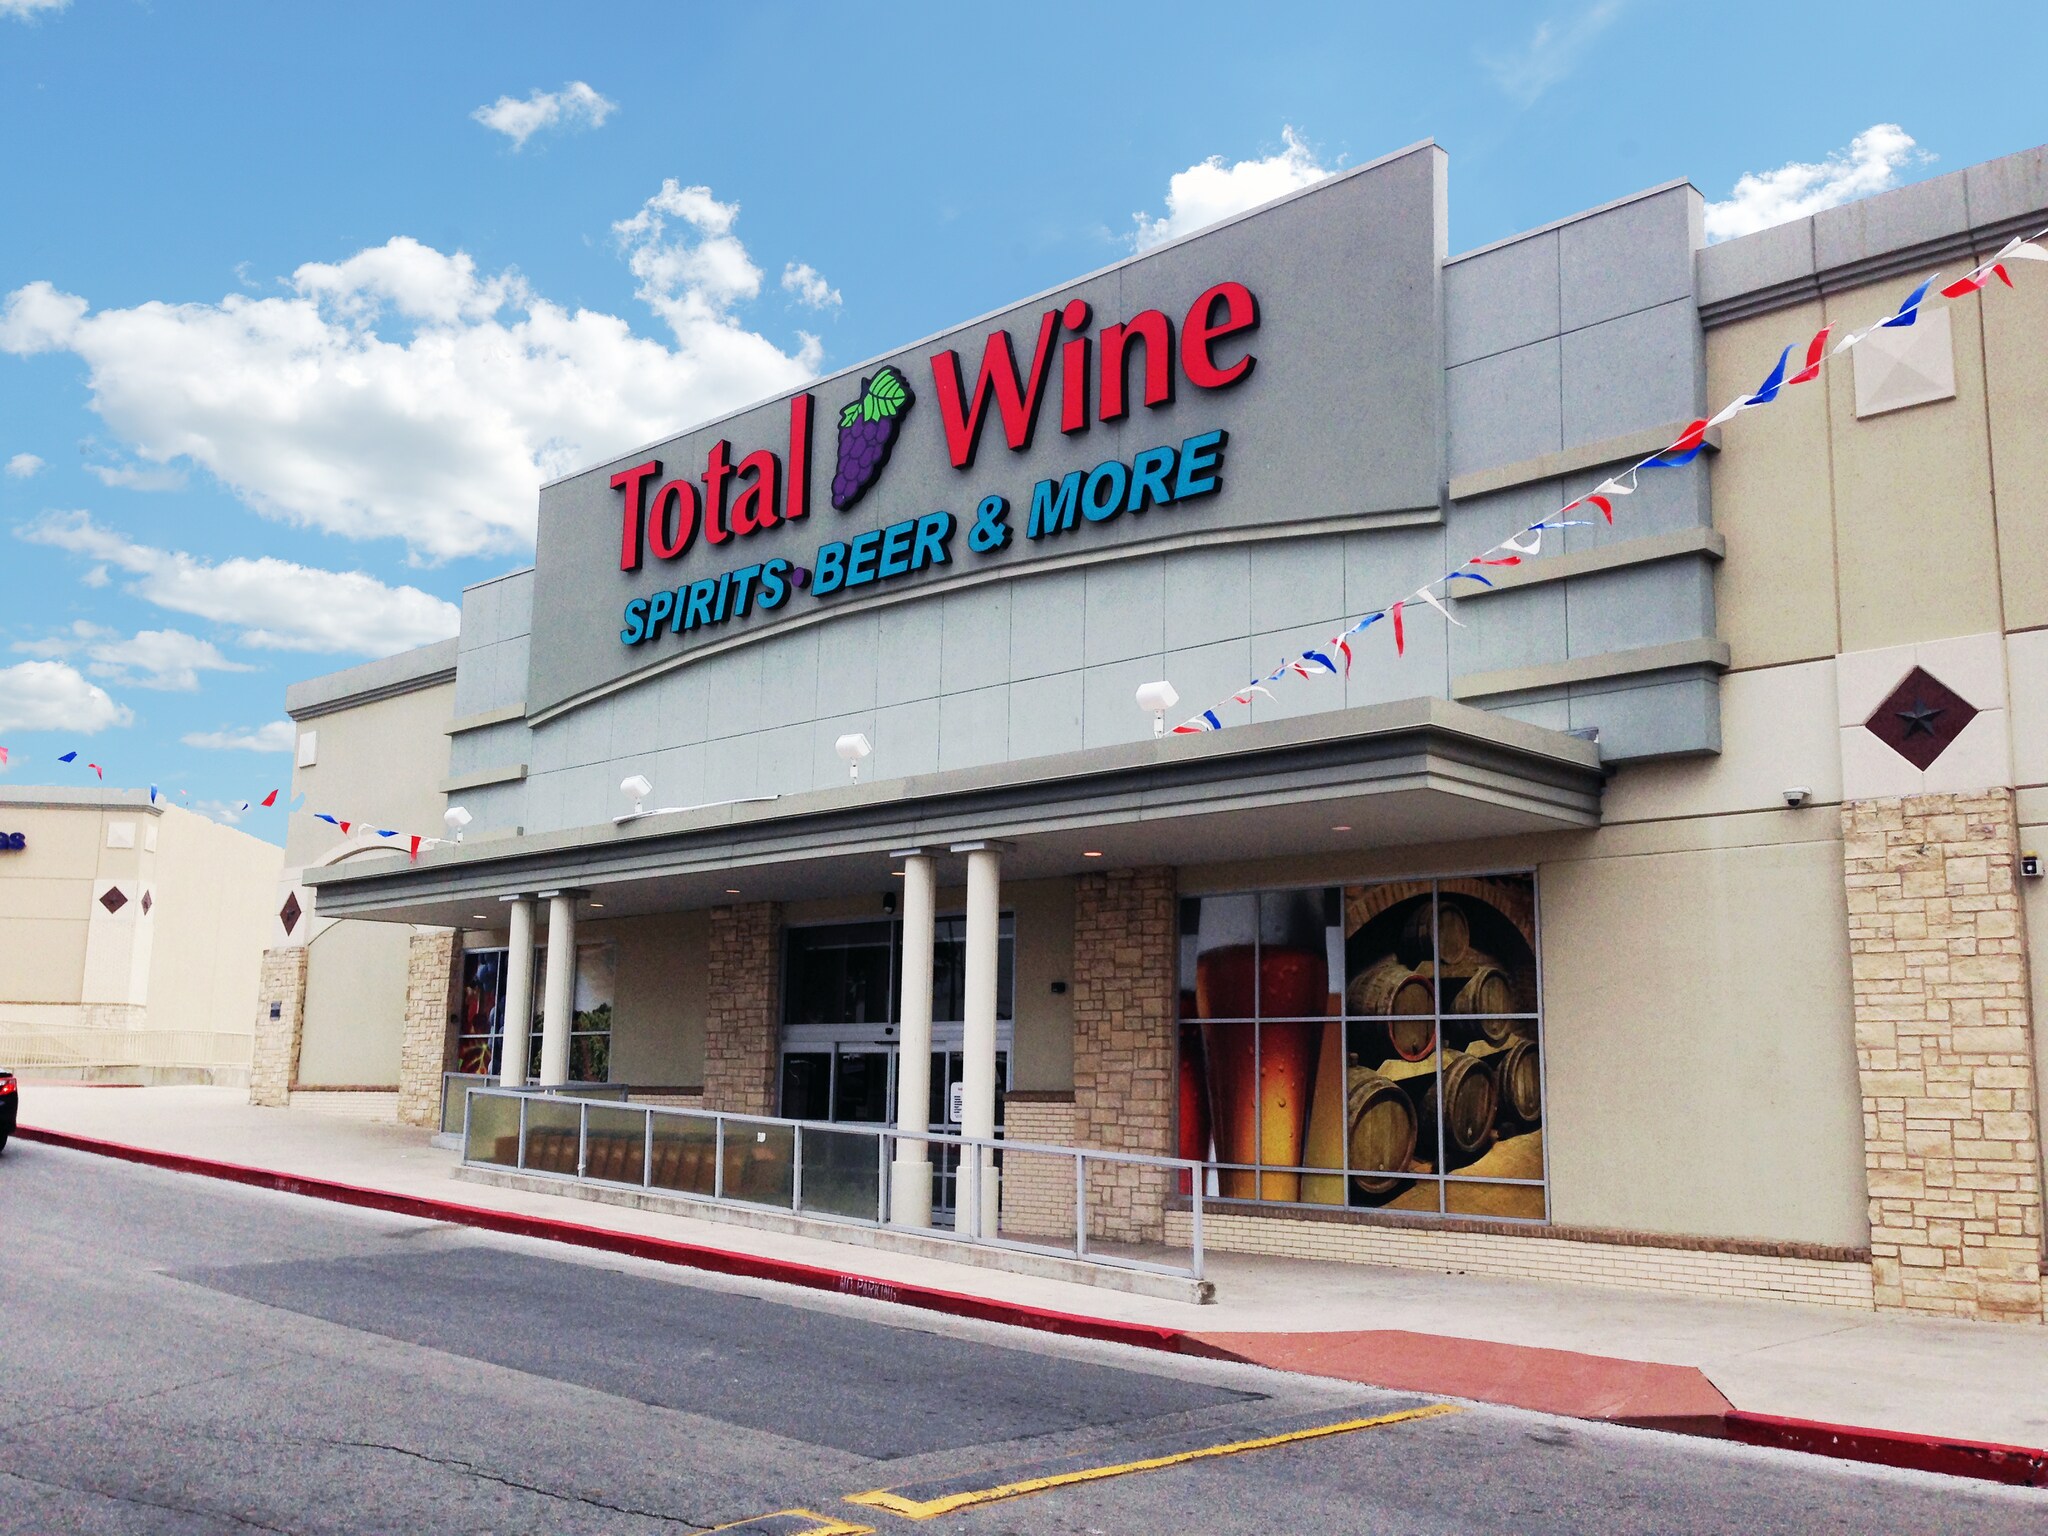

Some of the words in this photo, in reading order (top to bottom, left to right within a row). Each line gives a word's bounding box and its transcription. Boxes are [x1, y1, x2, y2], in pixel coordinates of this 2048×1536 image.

[610, 392, 815, 573] Total
[929, 281, 1261, 470] Wine
[968, 494, 1014, 554] &
[1026, 429, 1230, 540] MORE
